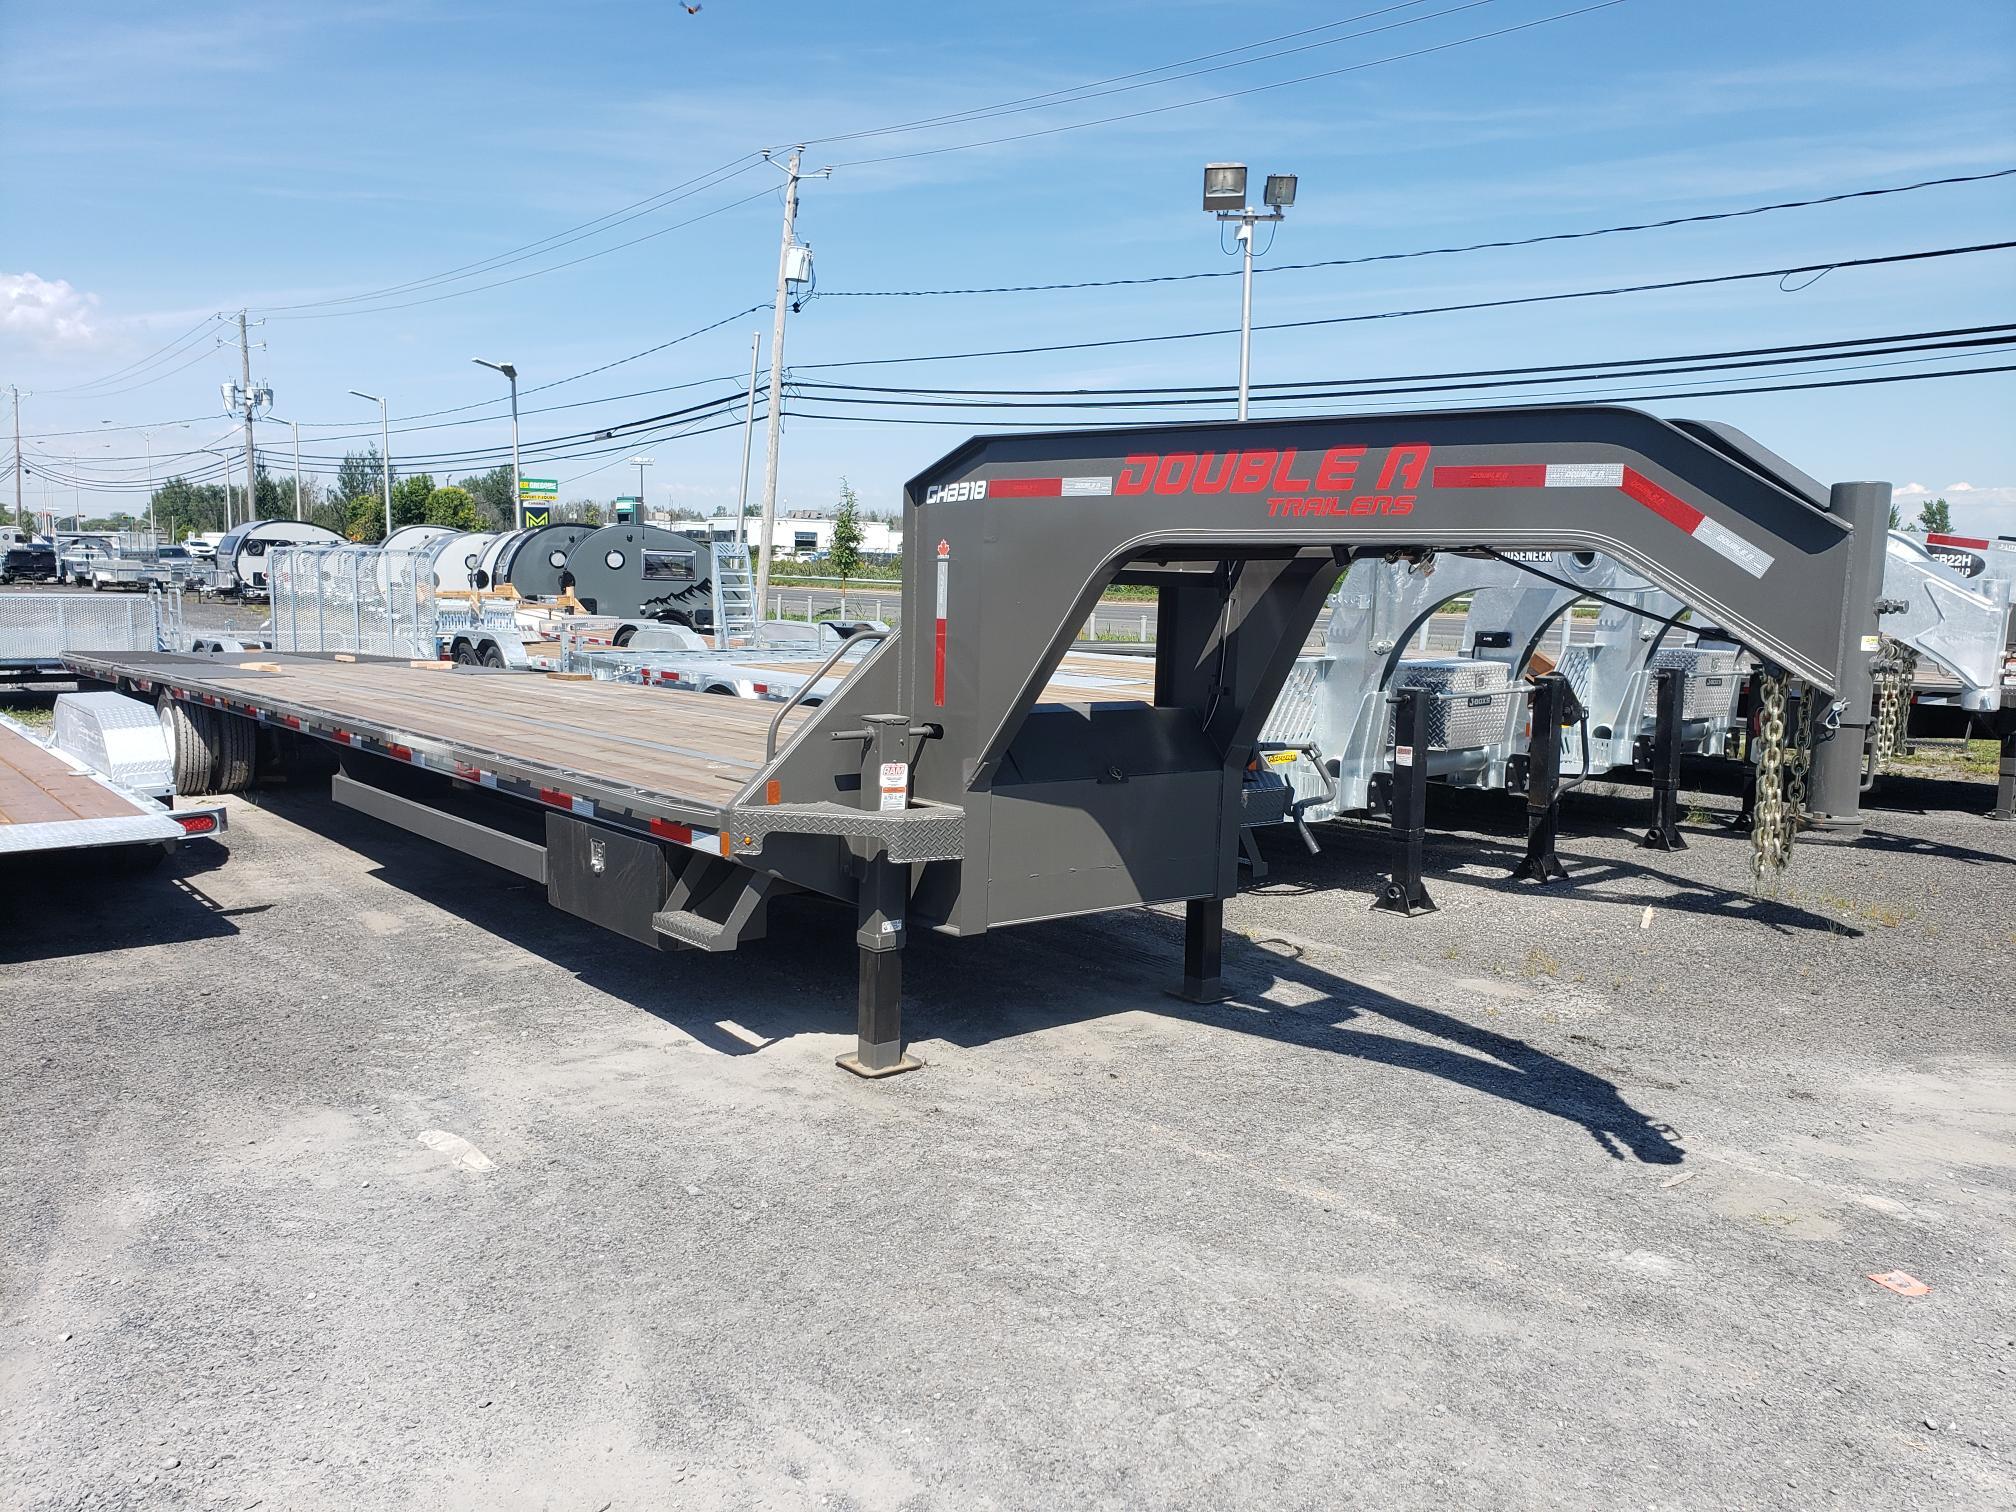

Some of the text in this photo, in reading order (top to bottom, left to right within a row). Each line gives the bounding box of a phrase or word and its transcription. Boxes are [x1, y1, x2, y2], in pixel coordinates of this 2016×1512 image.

[1114, 441, 1431, 496] DOUBLE A
[1267, 495, 1417, 517] TRAILERS
